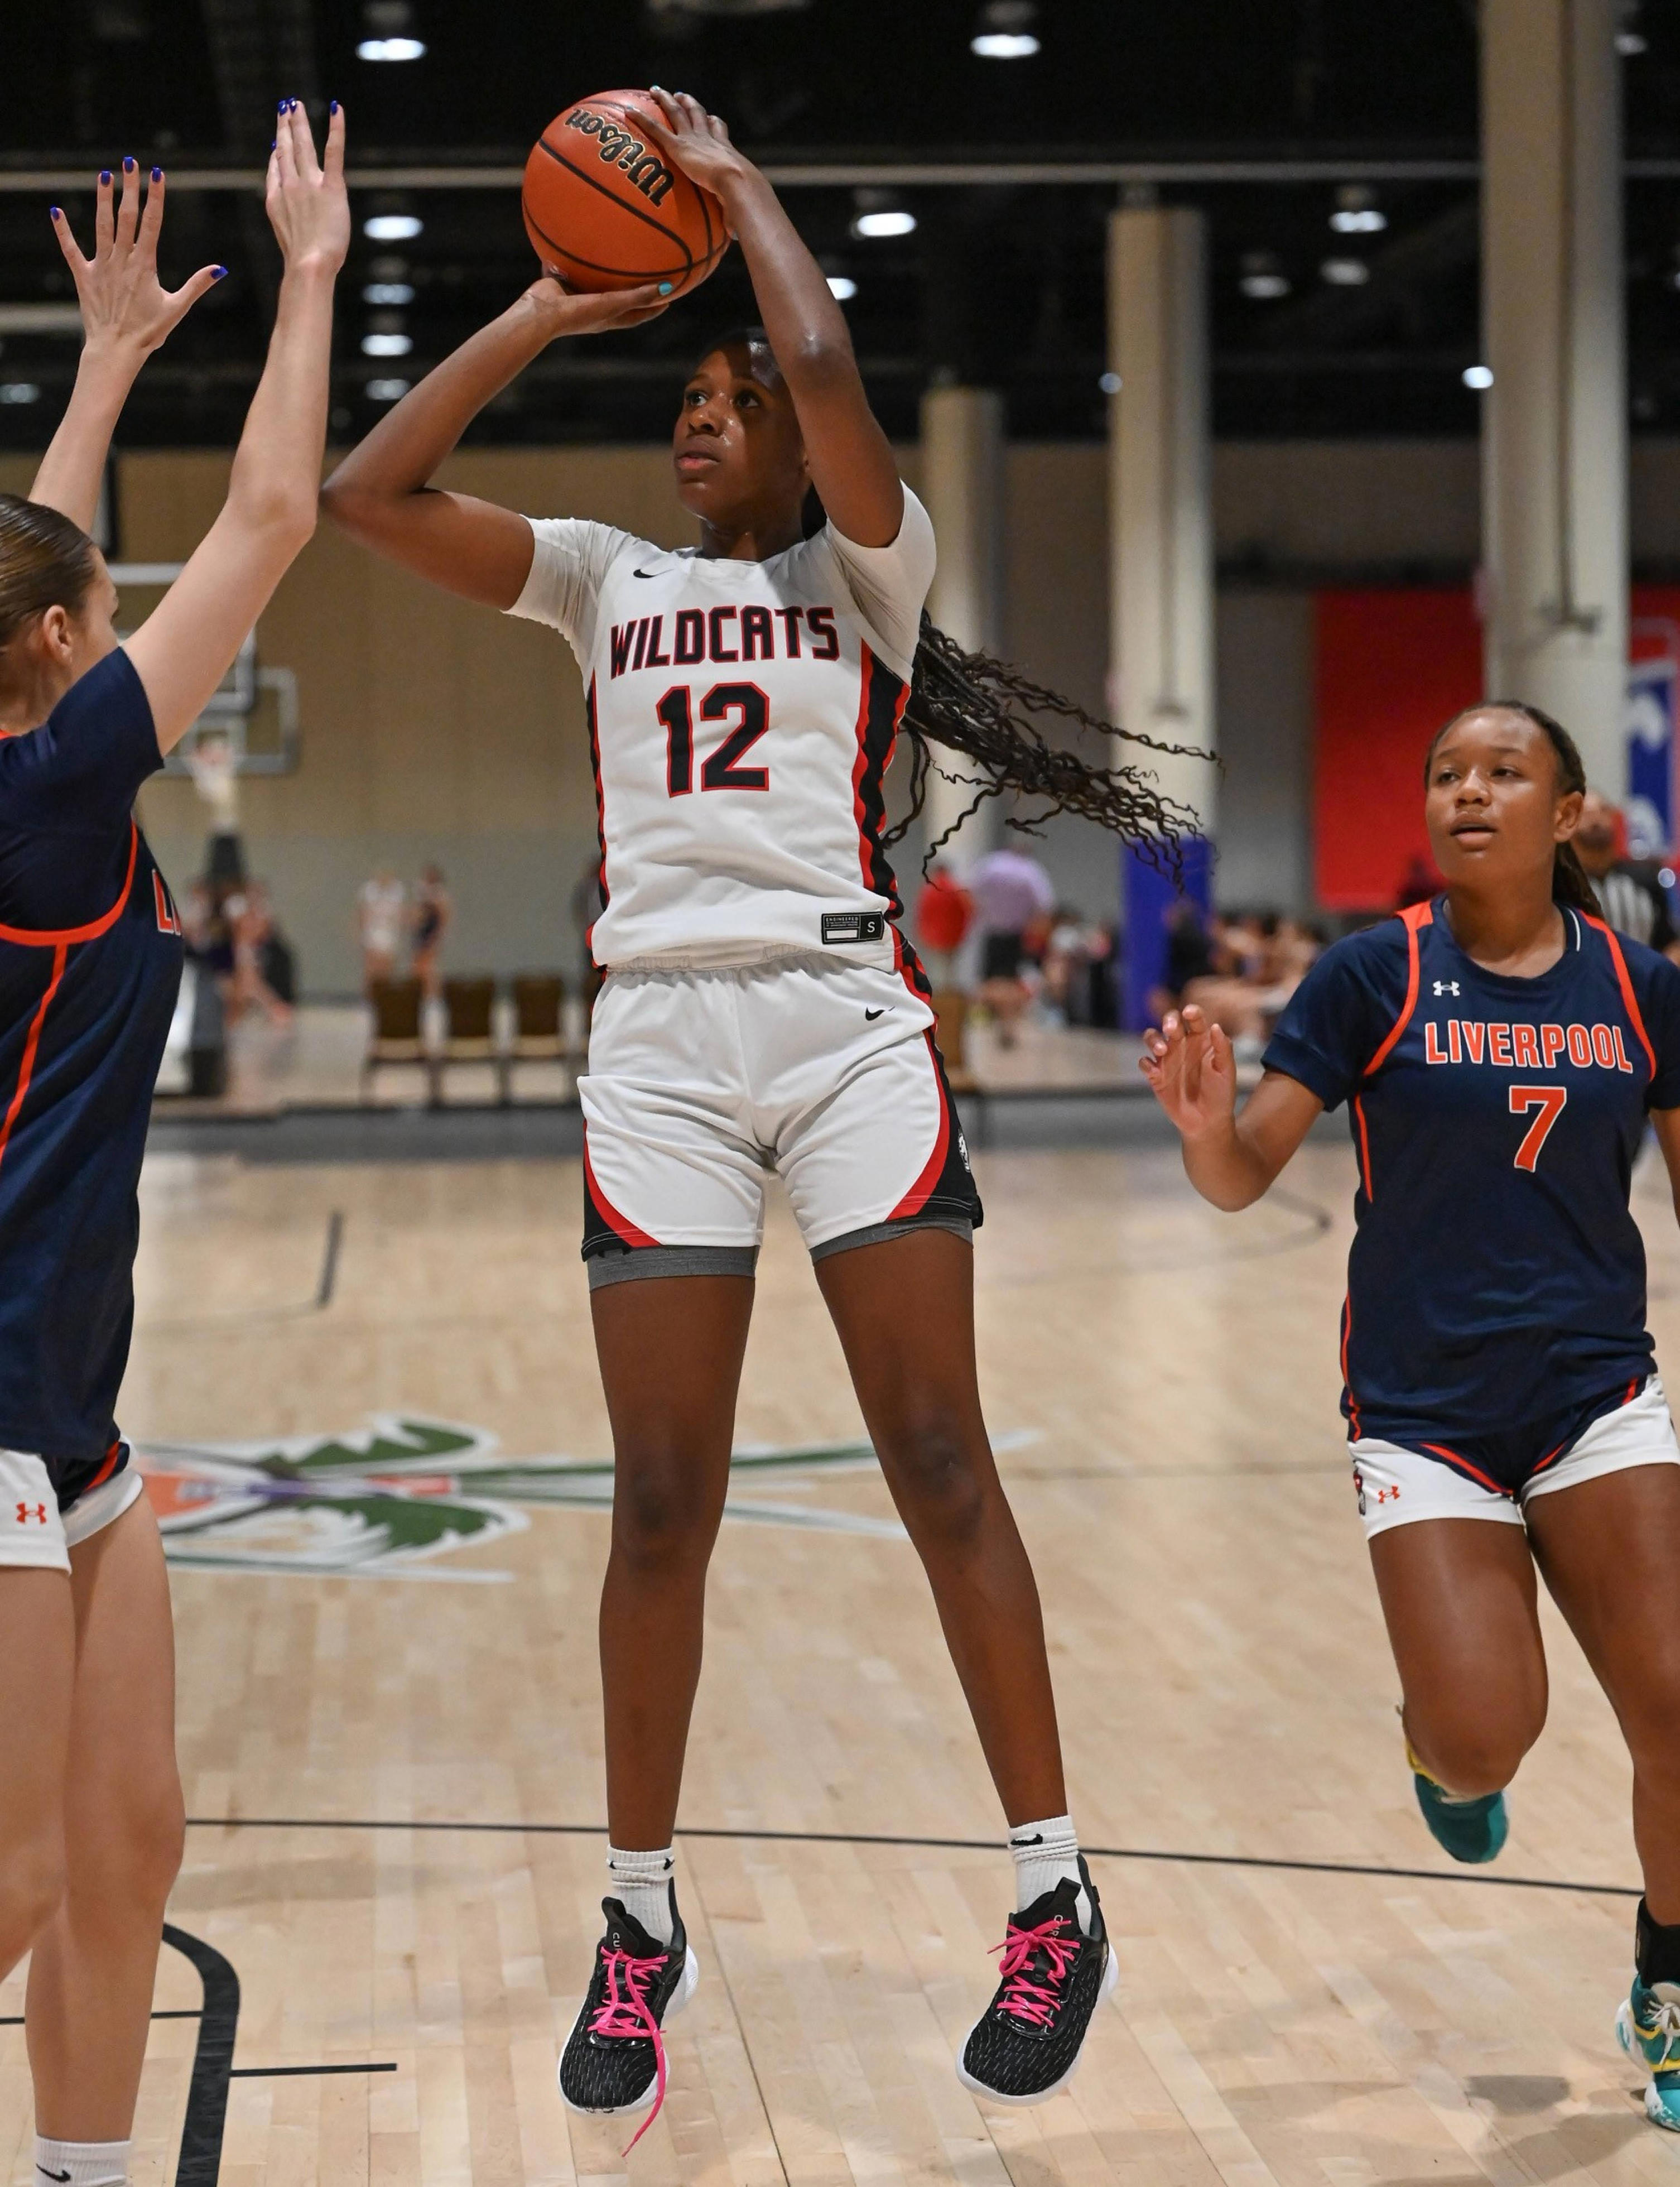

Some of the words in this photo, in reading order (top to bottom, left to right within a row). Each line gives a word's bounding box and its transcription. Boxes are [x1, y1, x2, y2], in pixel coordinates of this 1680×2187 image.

[563, 108, 675, 208] Wilson
[610, 605, 840, 680] WILDCATS
[656, 681, 770, 798] 12
[867, 921, 875, 933] S
[1424, 1020, 1634, 1074] LIVERPOOL
[1509, 1085, 1567, 1172] 7
